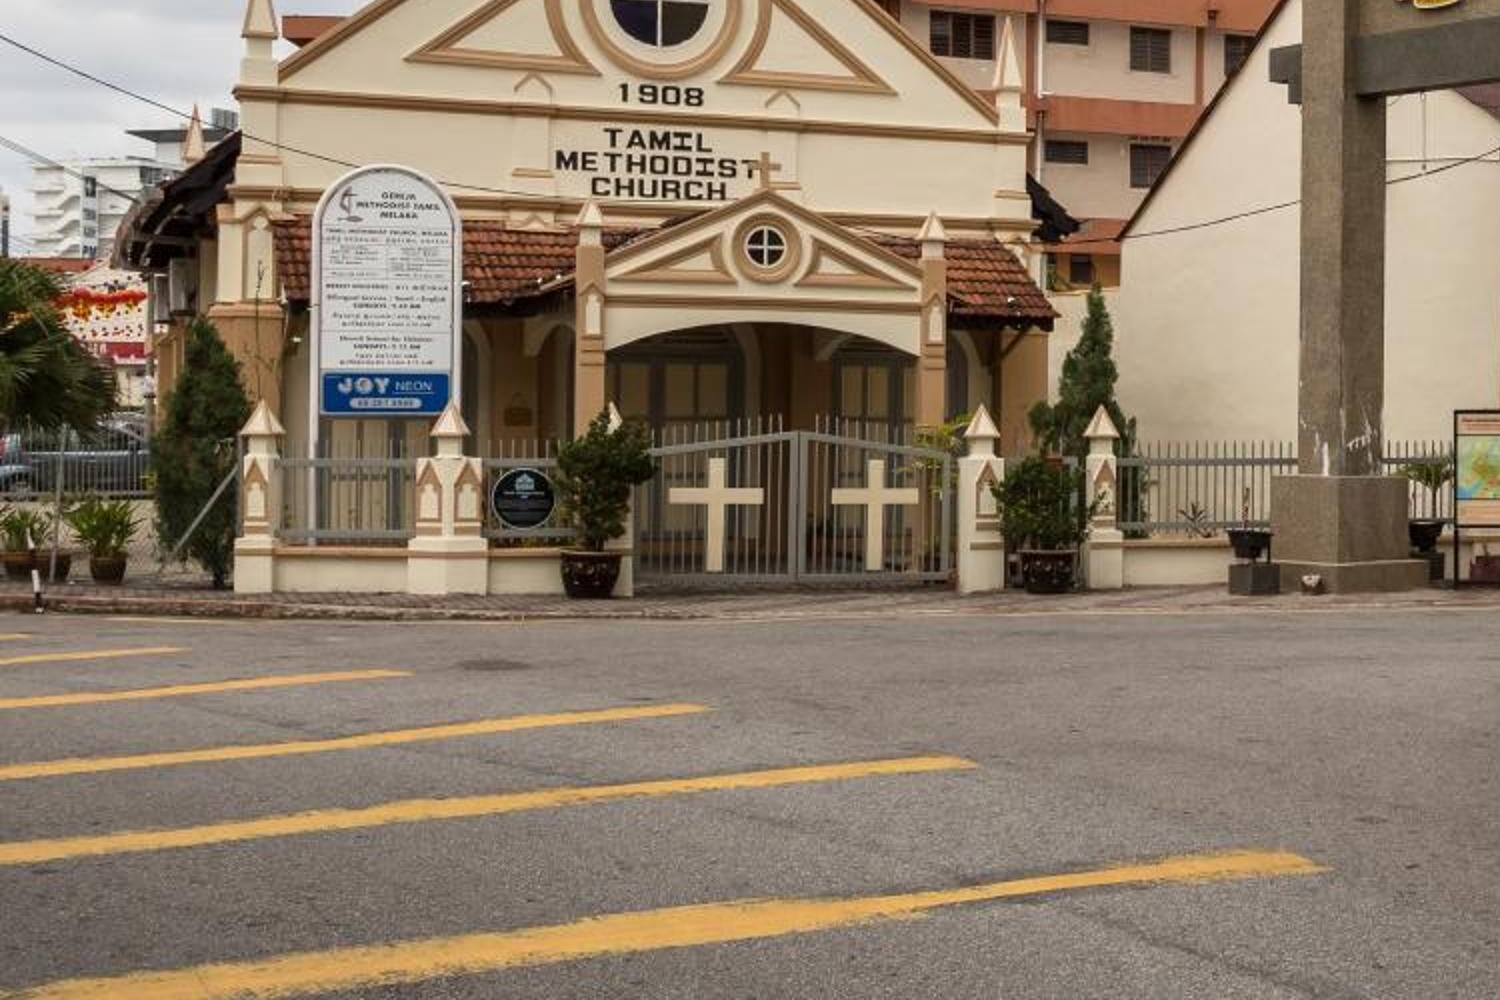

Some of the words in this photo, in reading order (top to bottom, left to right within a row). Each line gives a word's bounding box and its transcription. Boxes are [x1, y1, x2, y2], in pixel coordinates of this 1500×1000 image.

[619, 83, 704, 107] 1908
[603, 128, 712, 152] TAMIL
[556, 150, 760, 179] METHODIST
[591, 176, 726, 200] CHURCH
[338, 377, 390, 394] JOY
[395, 381, 433, 391] NEON
